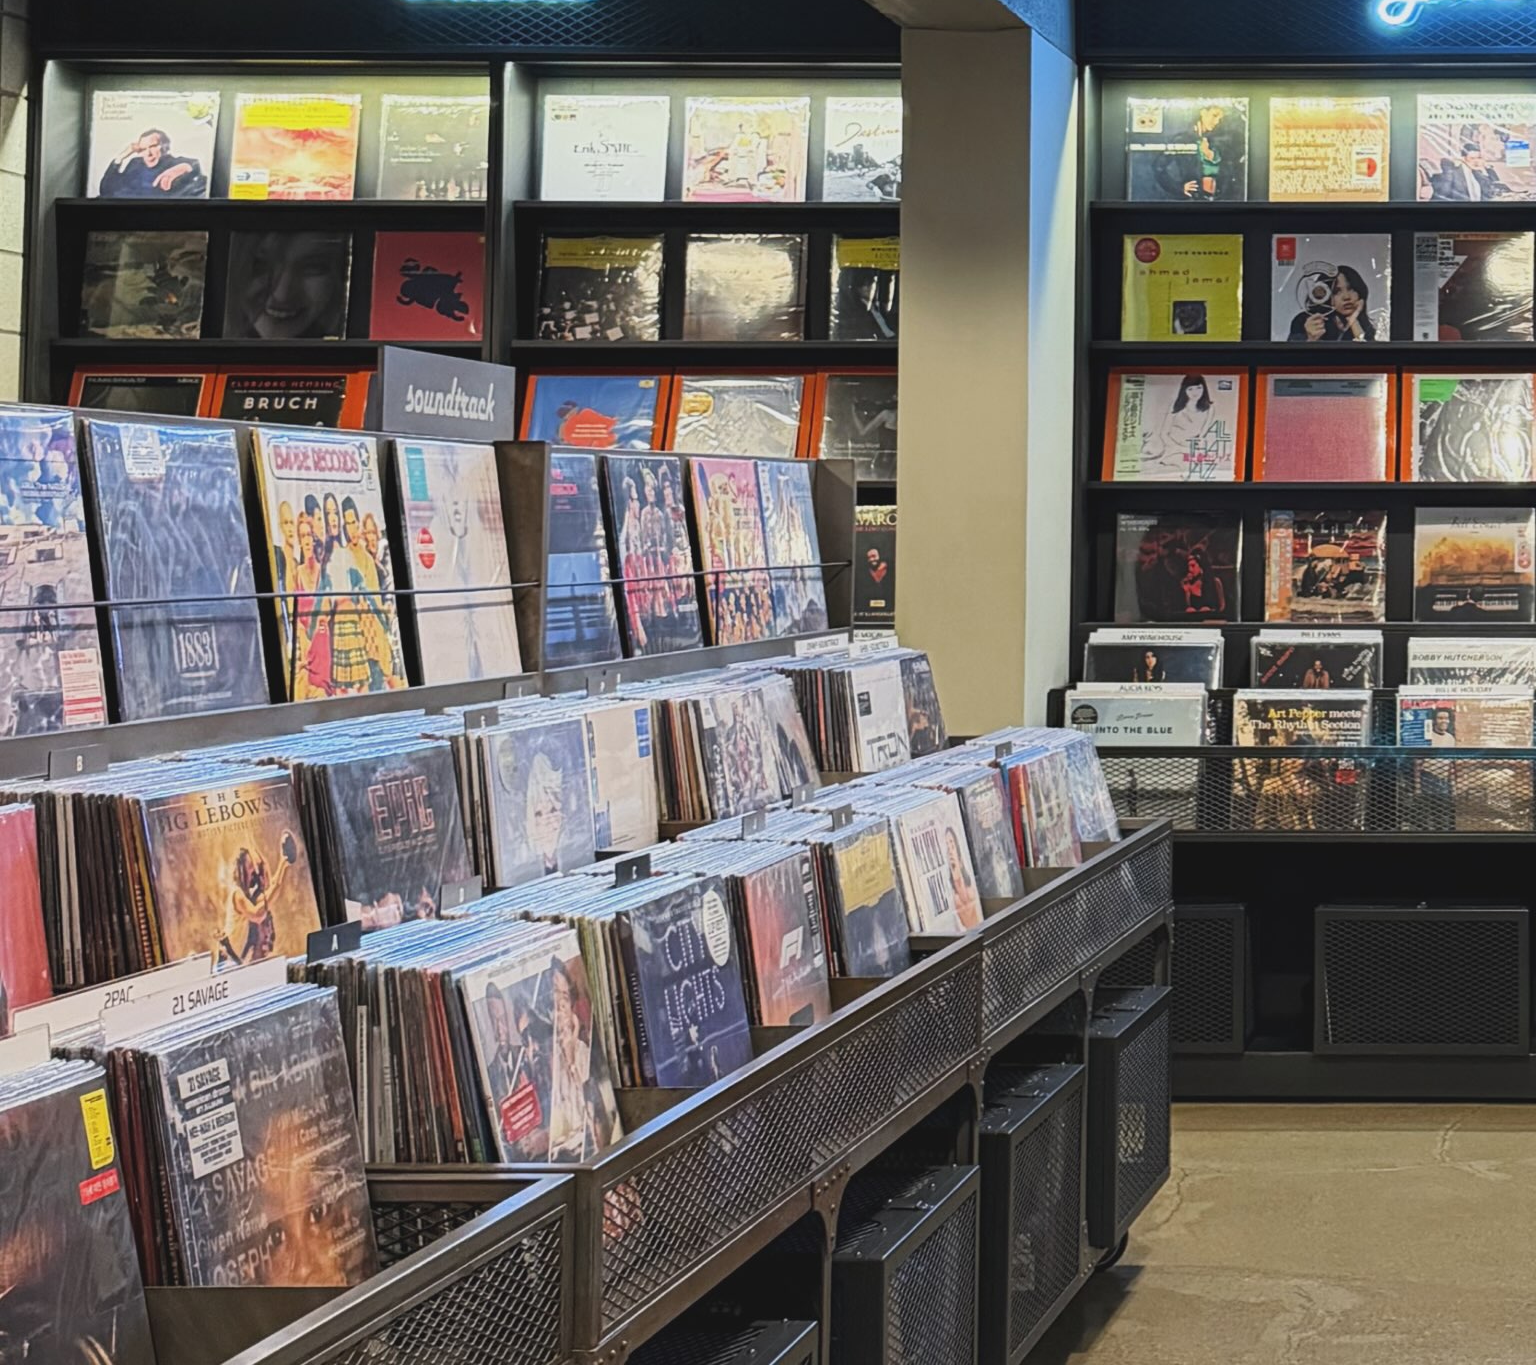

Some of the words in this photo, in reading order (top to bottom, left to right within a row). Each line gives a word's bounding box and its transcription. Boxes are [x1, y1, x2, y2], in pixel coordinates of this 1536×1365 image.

[243, 396, 318, 410] BRUCH
[405, 376, 496, 422] soundtrack
[177, 630, 214, 668] 1883
[1412, 653, 1441, 662] BOBBY
[1267, 708, 1286, 720] Art
[1287, 709, 1327, 723] Pepper
[1328, 709, 1362, 720] meets
[1095, 725, 1119, 734] INTO
[1121, 725, 1143, 734] THE
[1146, 725, 1174, 734] BLUE
[1250, 720, 1270, 731] The
[1318, 720, 1362, 731] Section
[200, 789, 241, 806] THE
[172, 996, 185, 1016] 21
[187, 980, 229, 1013] SAVAGE
